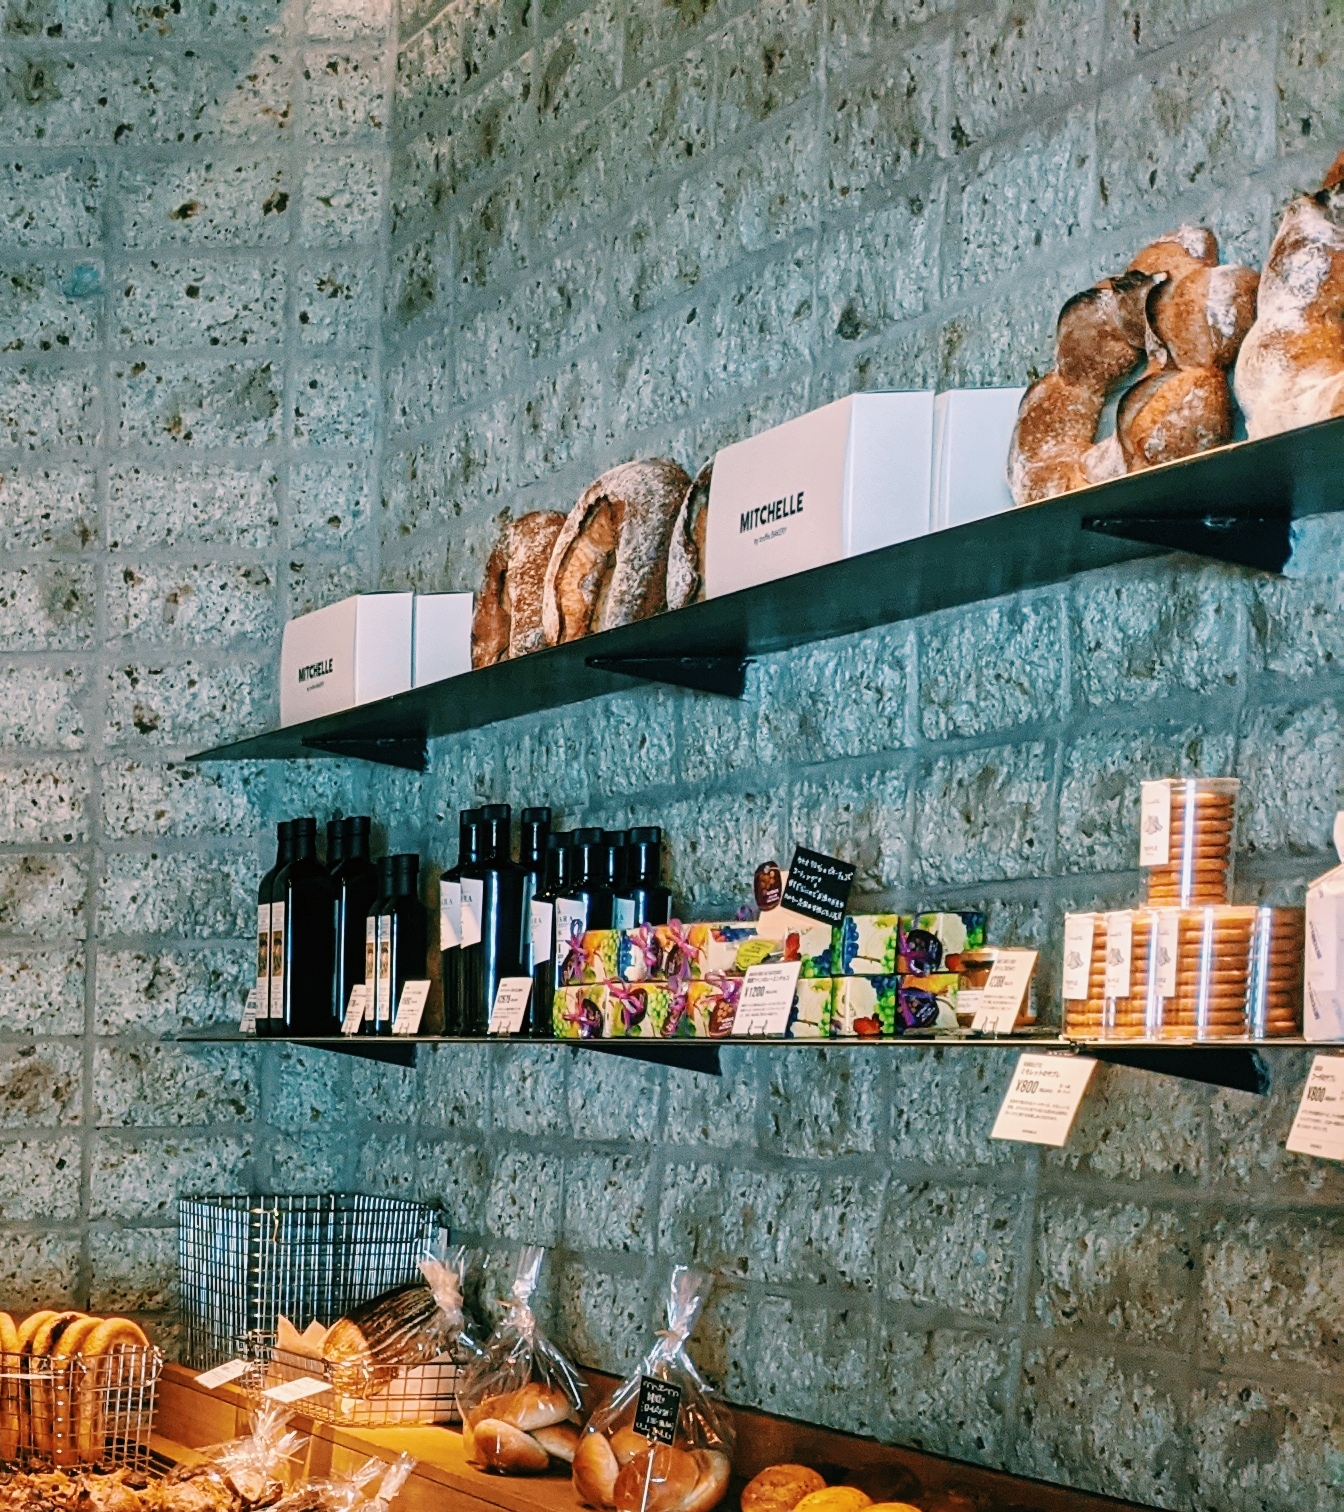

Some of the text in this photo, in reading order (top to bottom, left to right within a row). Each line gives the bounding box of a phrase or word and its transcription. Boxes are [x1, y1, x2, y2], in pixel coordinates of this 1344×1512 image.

[739, 491, 804, 533] MITCHELLE
[298, 657, 333, 683] MITCHELLE
[1015, 1079, 1040, 1095] ¥800
